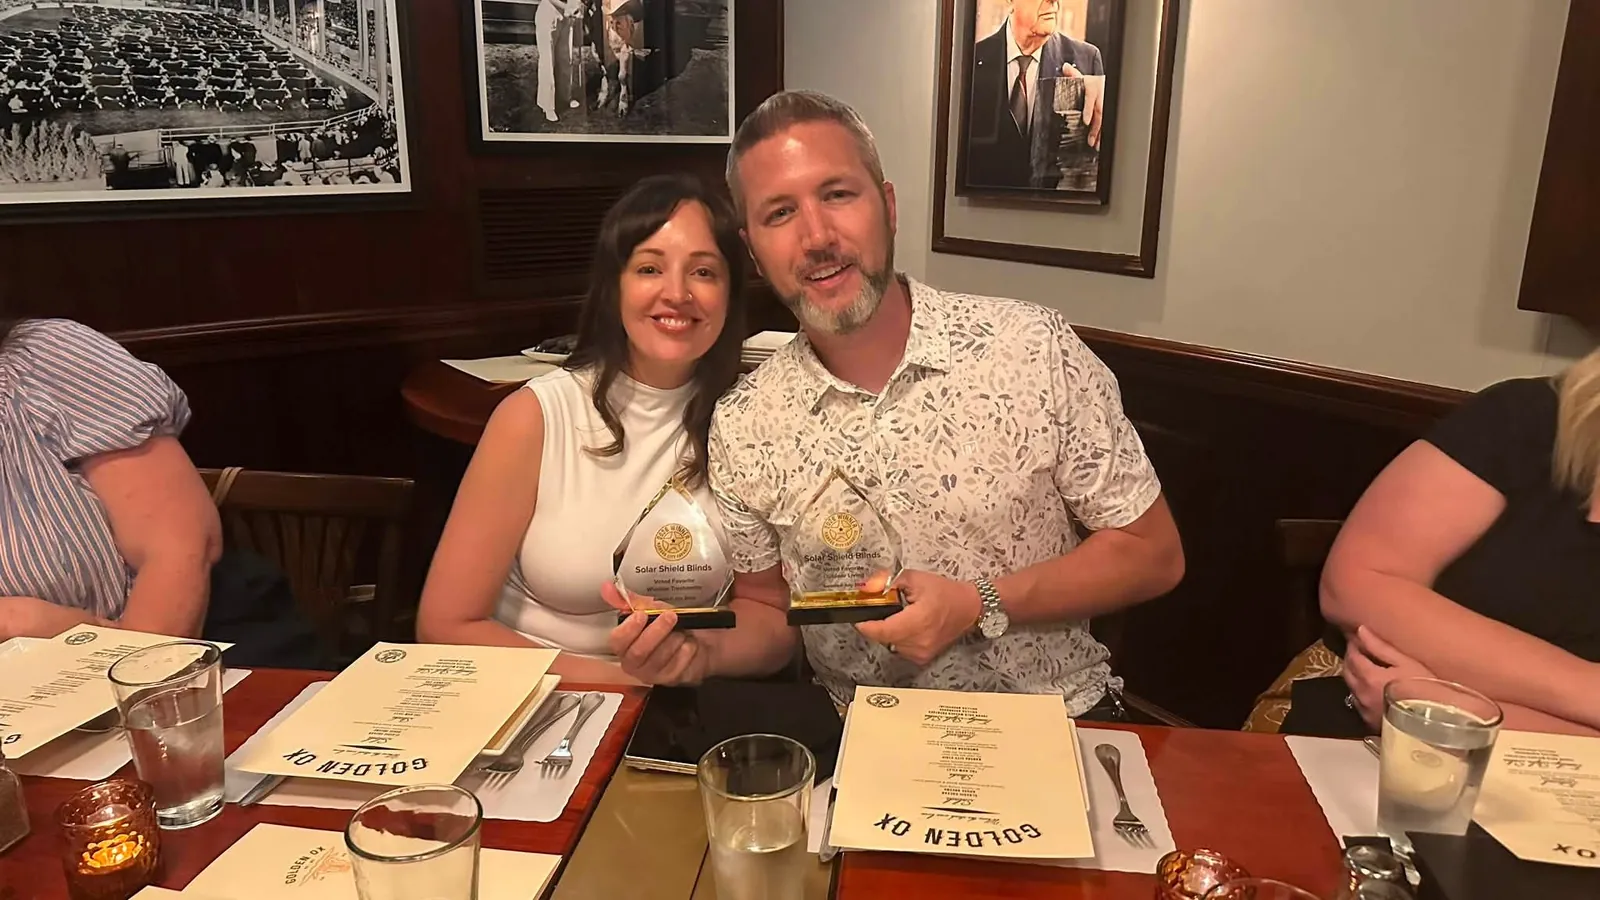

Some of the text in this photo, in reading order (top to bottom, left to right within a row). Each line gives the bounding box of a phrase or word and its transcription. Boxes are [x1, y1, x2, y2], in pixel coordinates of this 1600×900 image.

[837, 514, 858, 529] WINNER
[670, 525, 690, 540] WINNER
[804, 551, 881, 562] Solar Shield Blinds
[635, 563, 712, 574] Solar Shield Blinds
[282, 748, 317, 766] OX
[316, 757, 430, 776] GOLDEN
[873, 812, 1042, 848] GOLDEN OX
[1552, 843, 1597, 859] OX
[285, 855, 311, 885] GOLDEN
[309, 846, 326, 856] OX
